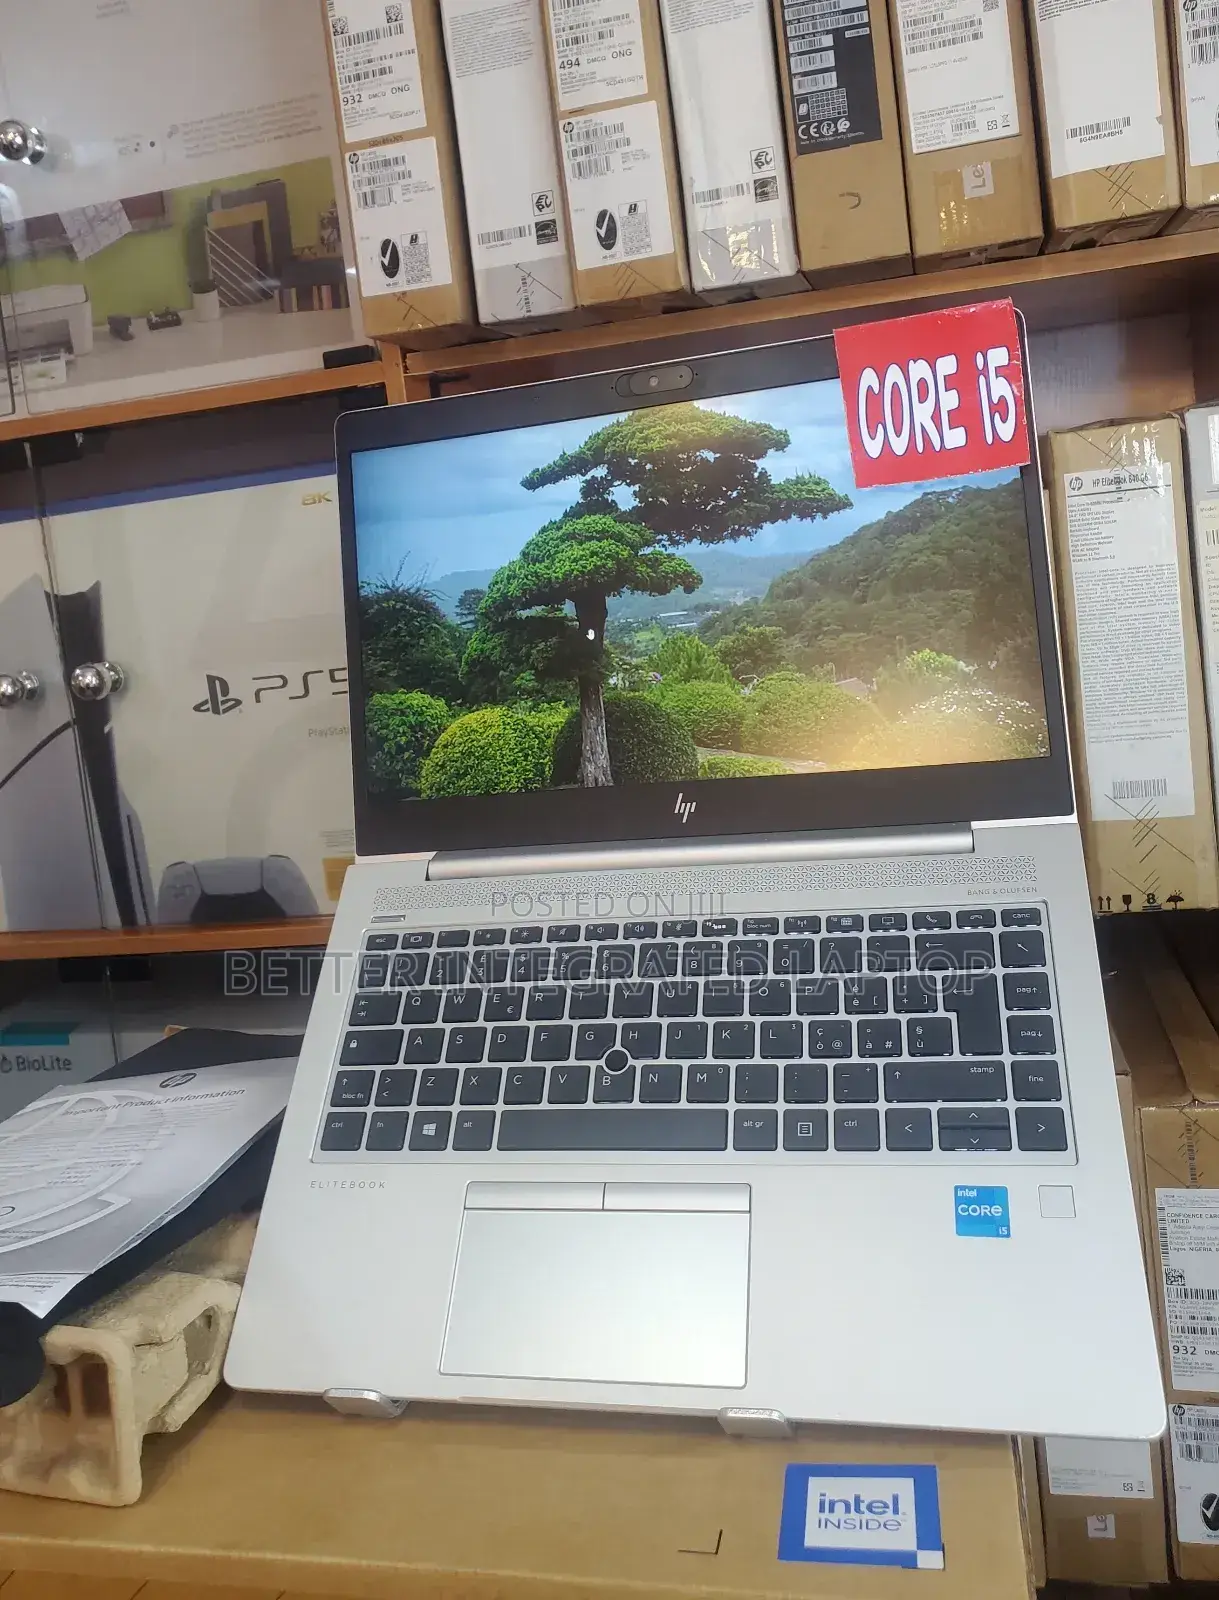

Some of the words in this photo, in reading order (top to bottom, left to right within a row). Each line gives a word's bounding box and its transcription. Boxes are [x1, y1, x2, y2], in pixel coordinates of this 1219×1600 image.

[559, 57, 580, 70] 494
[611, 48, 632, 59] ONG
[342, 93, 363, 106] 932
[391, 84, 410, 95] ONG
[857, 353, 968, 459] CORE
[975, 345, 1018, 445] i5
[1069, 476, 1083, 491] hp
[1092, 477, 1100, 488] HP
[302, 491, 332, 505] 8K
[674, 792, 697, 824] hp
[967, 888, 990, 896] BANG
[1000, 886, 1038, 895] OLUFSEN
[560, 964, 567, 973] 5
[602, 963, 609, 972] 6
[690, 960, 698, 969] 8
[436, 969, 444, 978] 2
[477, 967, 484, 976] 3
[517, 966, 525, 975] 4
[622, 989, 631, 999] Y
[666, 988, 675, 998] U
[758, 986, 769, 997] O
[805, 986, 813, 996] P
[411, 996, 421, 1006] Q
[453, 995, 466, 1004] W
[493, 993, 502, 1003] E
[535, 992, 544, 1002] R
[506, 1005, 515, 1014] €
[455, 1034, 464, 1044] S
[497, 1033, 507, 1043] D
[540, 1032, 549, 1042] F
[585, 1031, 594, 1041] G
[629, 1030, 638, 1040] H
[674, 1029, 682, 1040] J
[722, 1029, 731, 1039] K
[769, 1029, 777, 1039] L
[413, 1036, 423, 1045] A
[831, 1040, 843, 1050] @
[884, 1040, 893, 1049] #
[16, 1055, 73, 1072] BioLite
[969, 1066, 995, 1074] stamp
[426, 1077, 436, 1086] Z
[469, 1076, 479, 1085] X
[513, 1075, 522, 1085] C
[558, 1074, 568, 1084] V
[602, 1076, 611, 1086] B
[648, 1073, 658, 1083] N
[696, 1073, 707, 1083] M
[122, 1096, 170, 1108] Product
[170, 1088, 246, 1103] Information
[310, 1180, 386, 1189] ELITEBOOK
[957, 1188, 977, 1197] intel
[998, 1226, 1008, 1235] i5
[1172, 1344, 1197, 1356] 932
